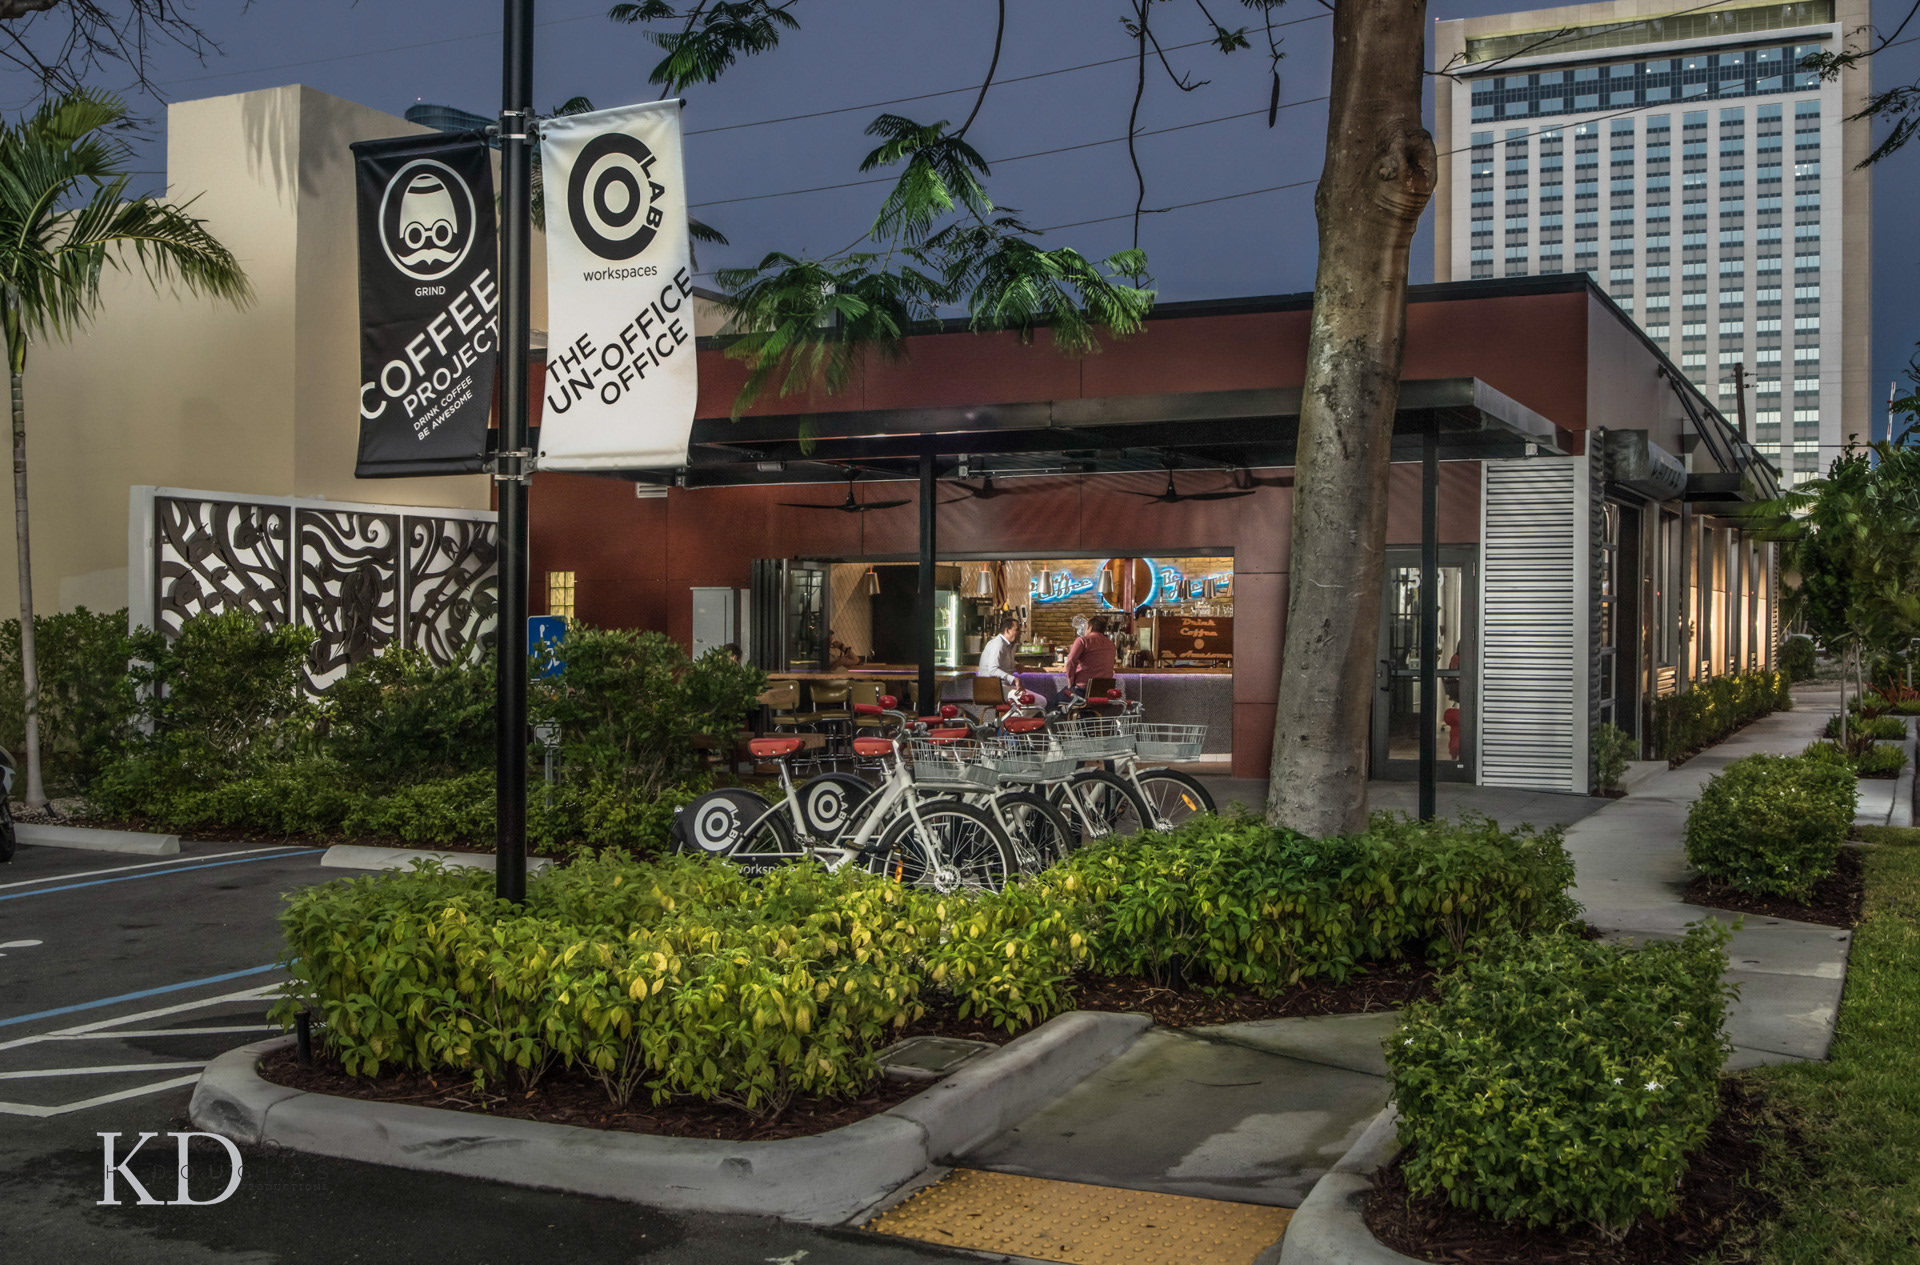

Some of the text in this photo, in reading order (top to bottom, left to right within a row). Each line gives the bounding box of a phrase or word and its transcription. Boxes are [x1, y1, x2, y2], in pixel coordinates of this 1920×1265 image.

[414, 285, 446, 297] GRIND
[583, 264, 658, 282] workspaces
[360, 268, 499, 420] COFFEE
[402, 315, 499, 419] PROJECT
[546, 332, 597, 385] THE
[547, 266, 693, 415] UN-OFFICE
[600, 317, 689, 405] OFFICE
[413, 375, 473, 431] DRINK COFFEE
[417, 389, 474, 441] BE AWESOME
